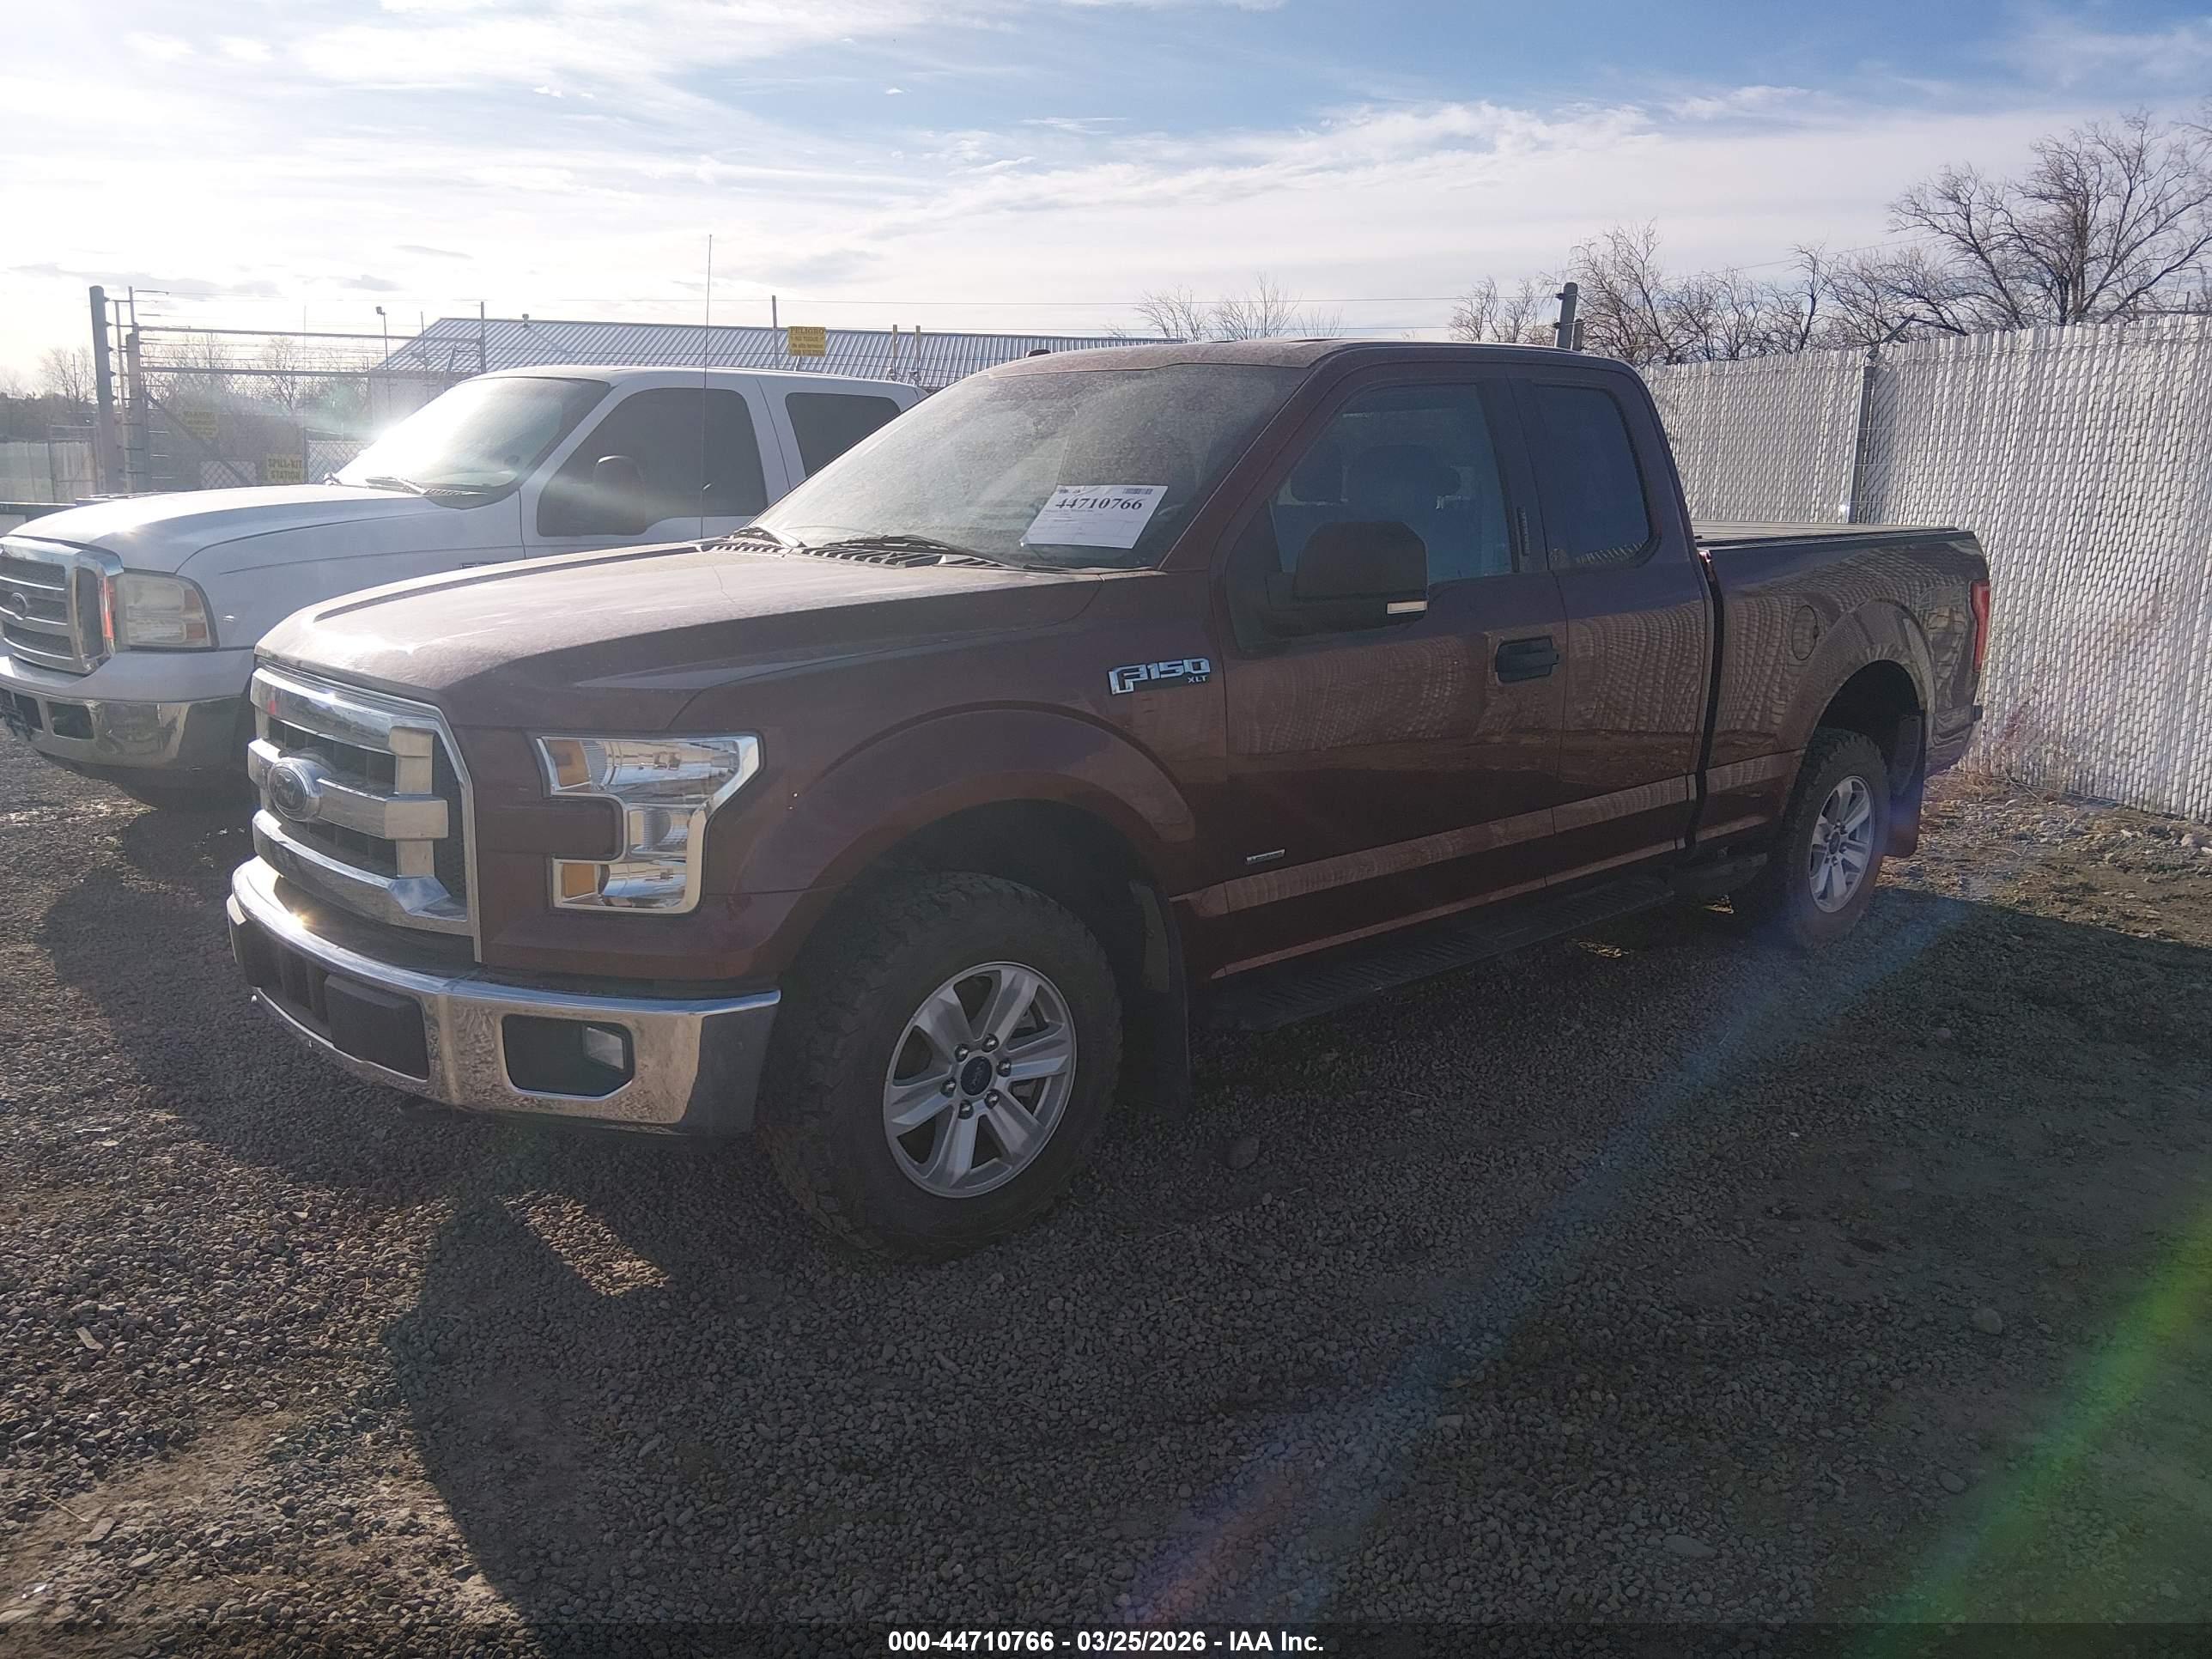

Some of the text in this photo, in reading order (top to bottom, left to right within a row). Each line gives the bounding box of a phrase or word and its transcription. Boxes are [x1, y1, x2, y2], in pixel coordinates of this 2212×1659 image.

[270, 471, 301, 480] STATION
[1055, 497, 1146, 510] 44710766
[1188, 675, 1207, 684] XLT
